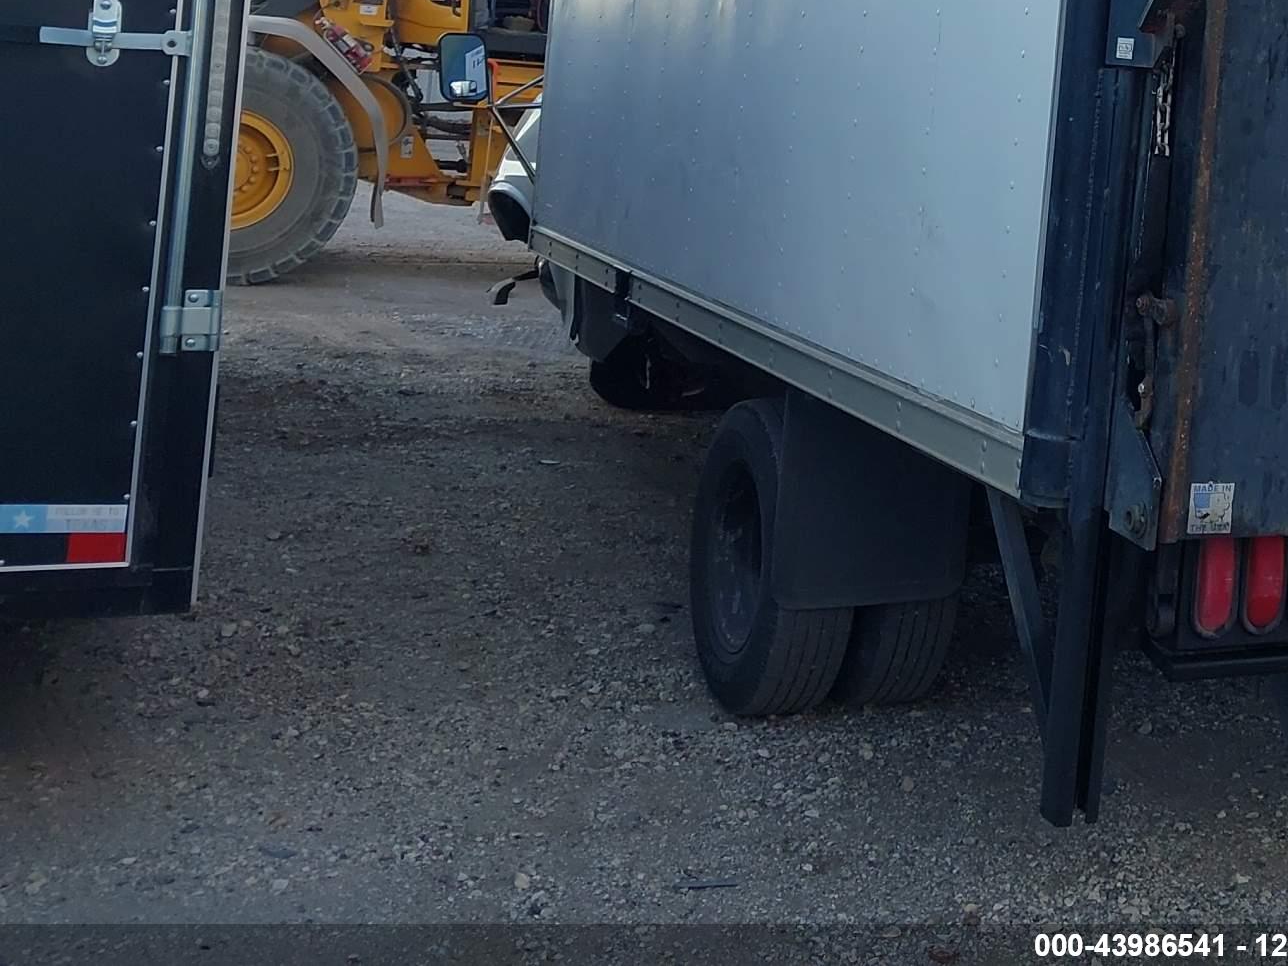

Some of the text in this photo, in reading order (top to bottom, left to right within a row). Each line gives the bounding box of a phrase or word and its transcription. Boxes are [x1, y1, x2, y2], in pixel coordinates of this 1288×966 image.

[1193, 484, 1232, 492] MADE IN
[1190, 524, 1207, 533] THE
